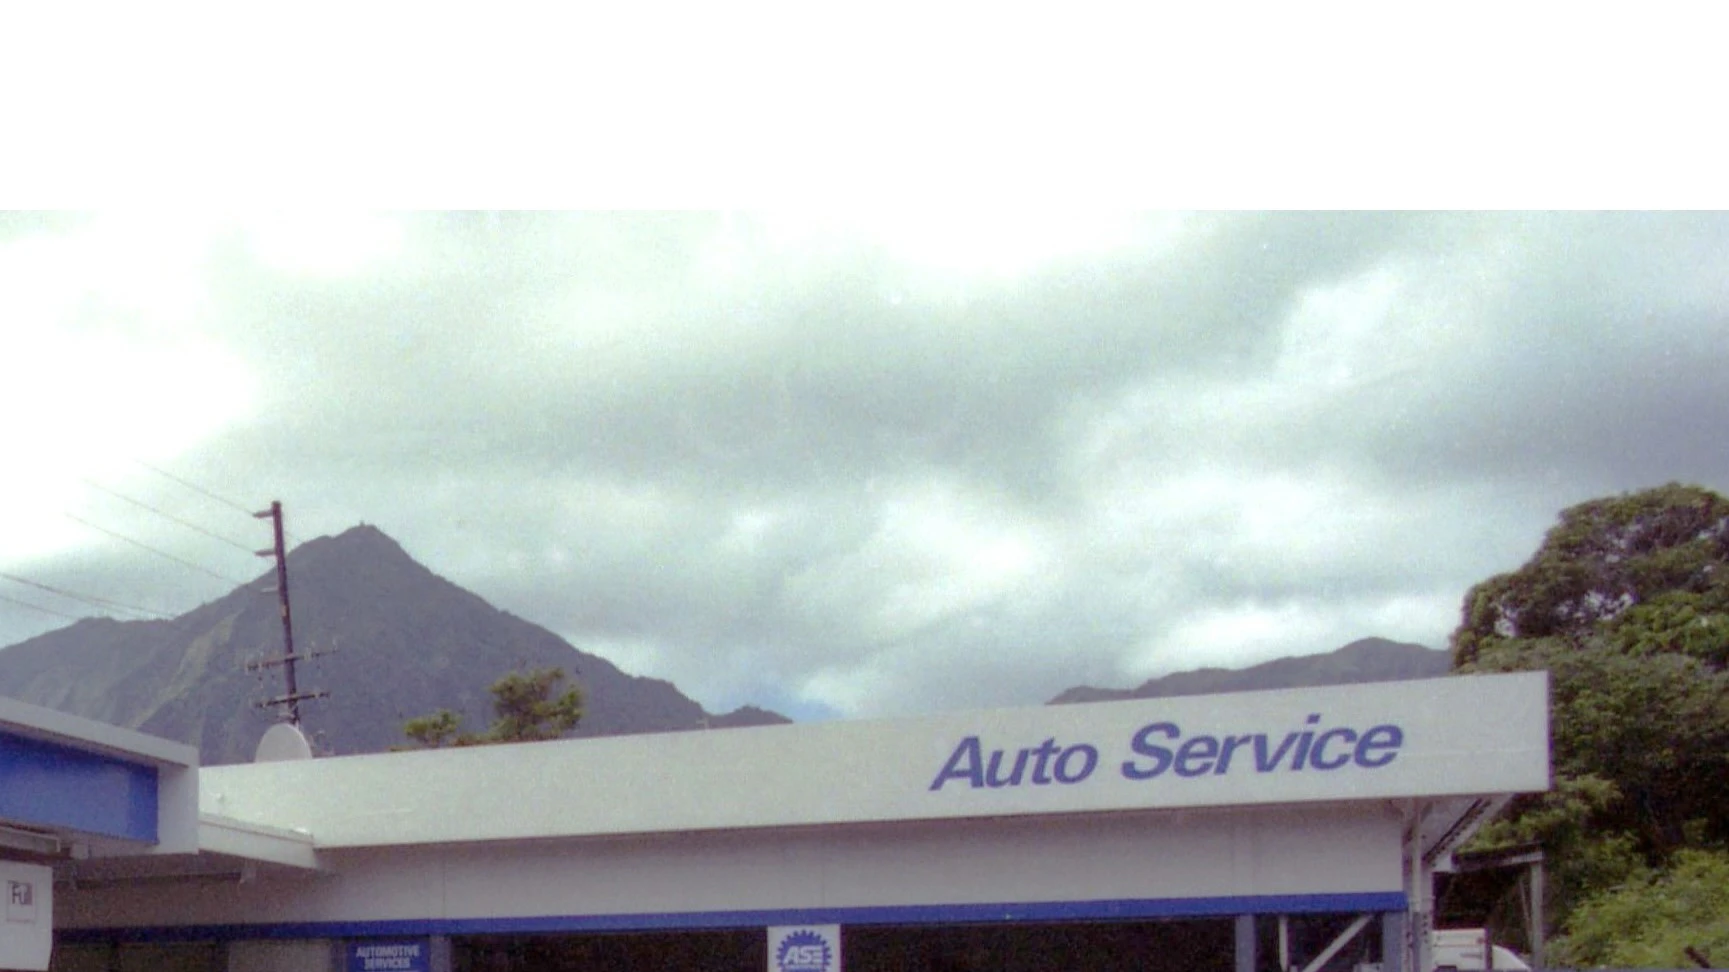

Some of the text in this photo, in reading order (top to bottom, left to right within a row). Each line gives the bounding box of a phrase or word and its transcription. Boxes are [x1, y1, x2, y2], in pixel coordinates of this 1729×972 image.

[929, 714, 1404, 791] Auto Service
[356, 944, 420, 958] AUTOMOTIVE
[783, 945, 824, 965] ASE
[364, 957, 411, 970] SERVICES
